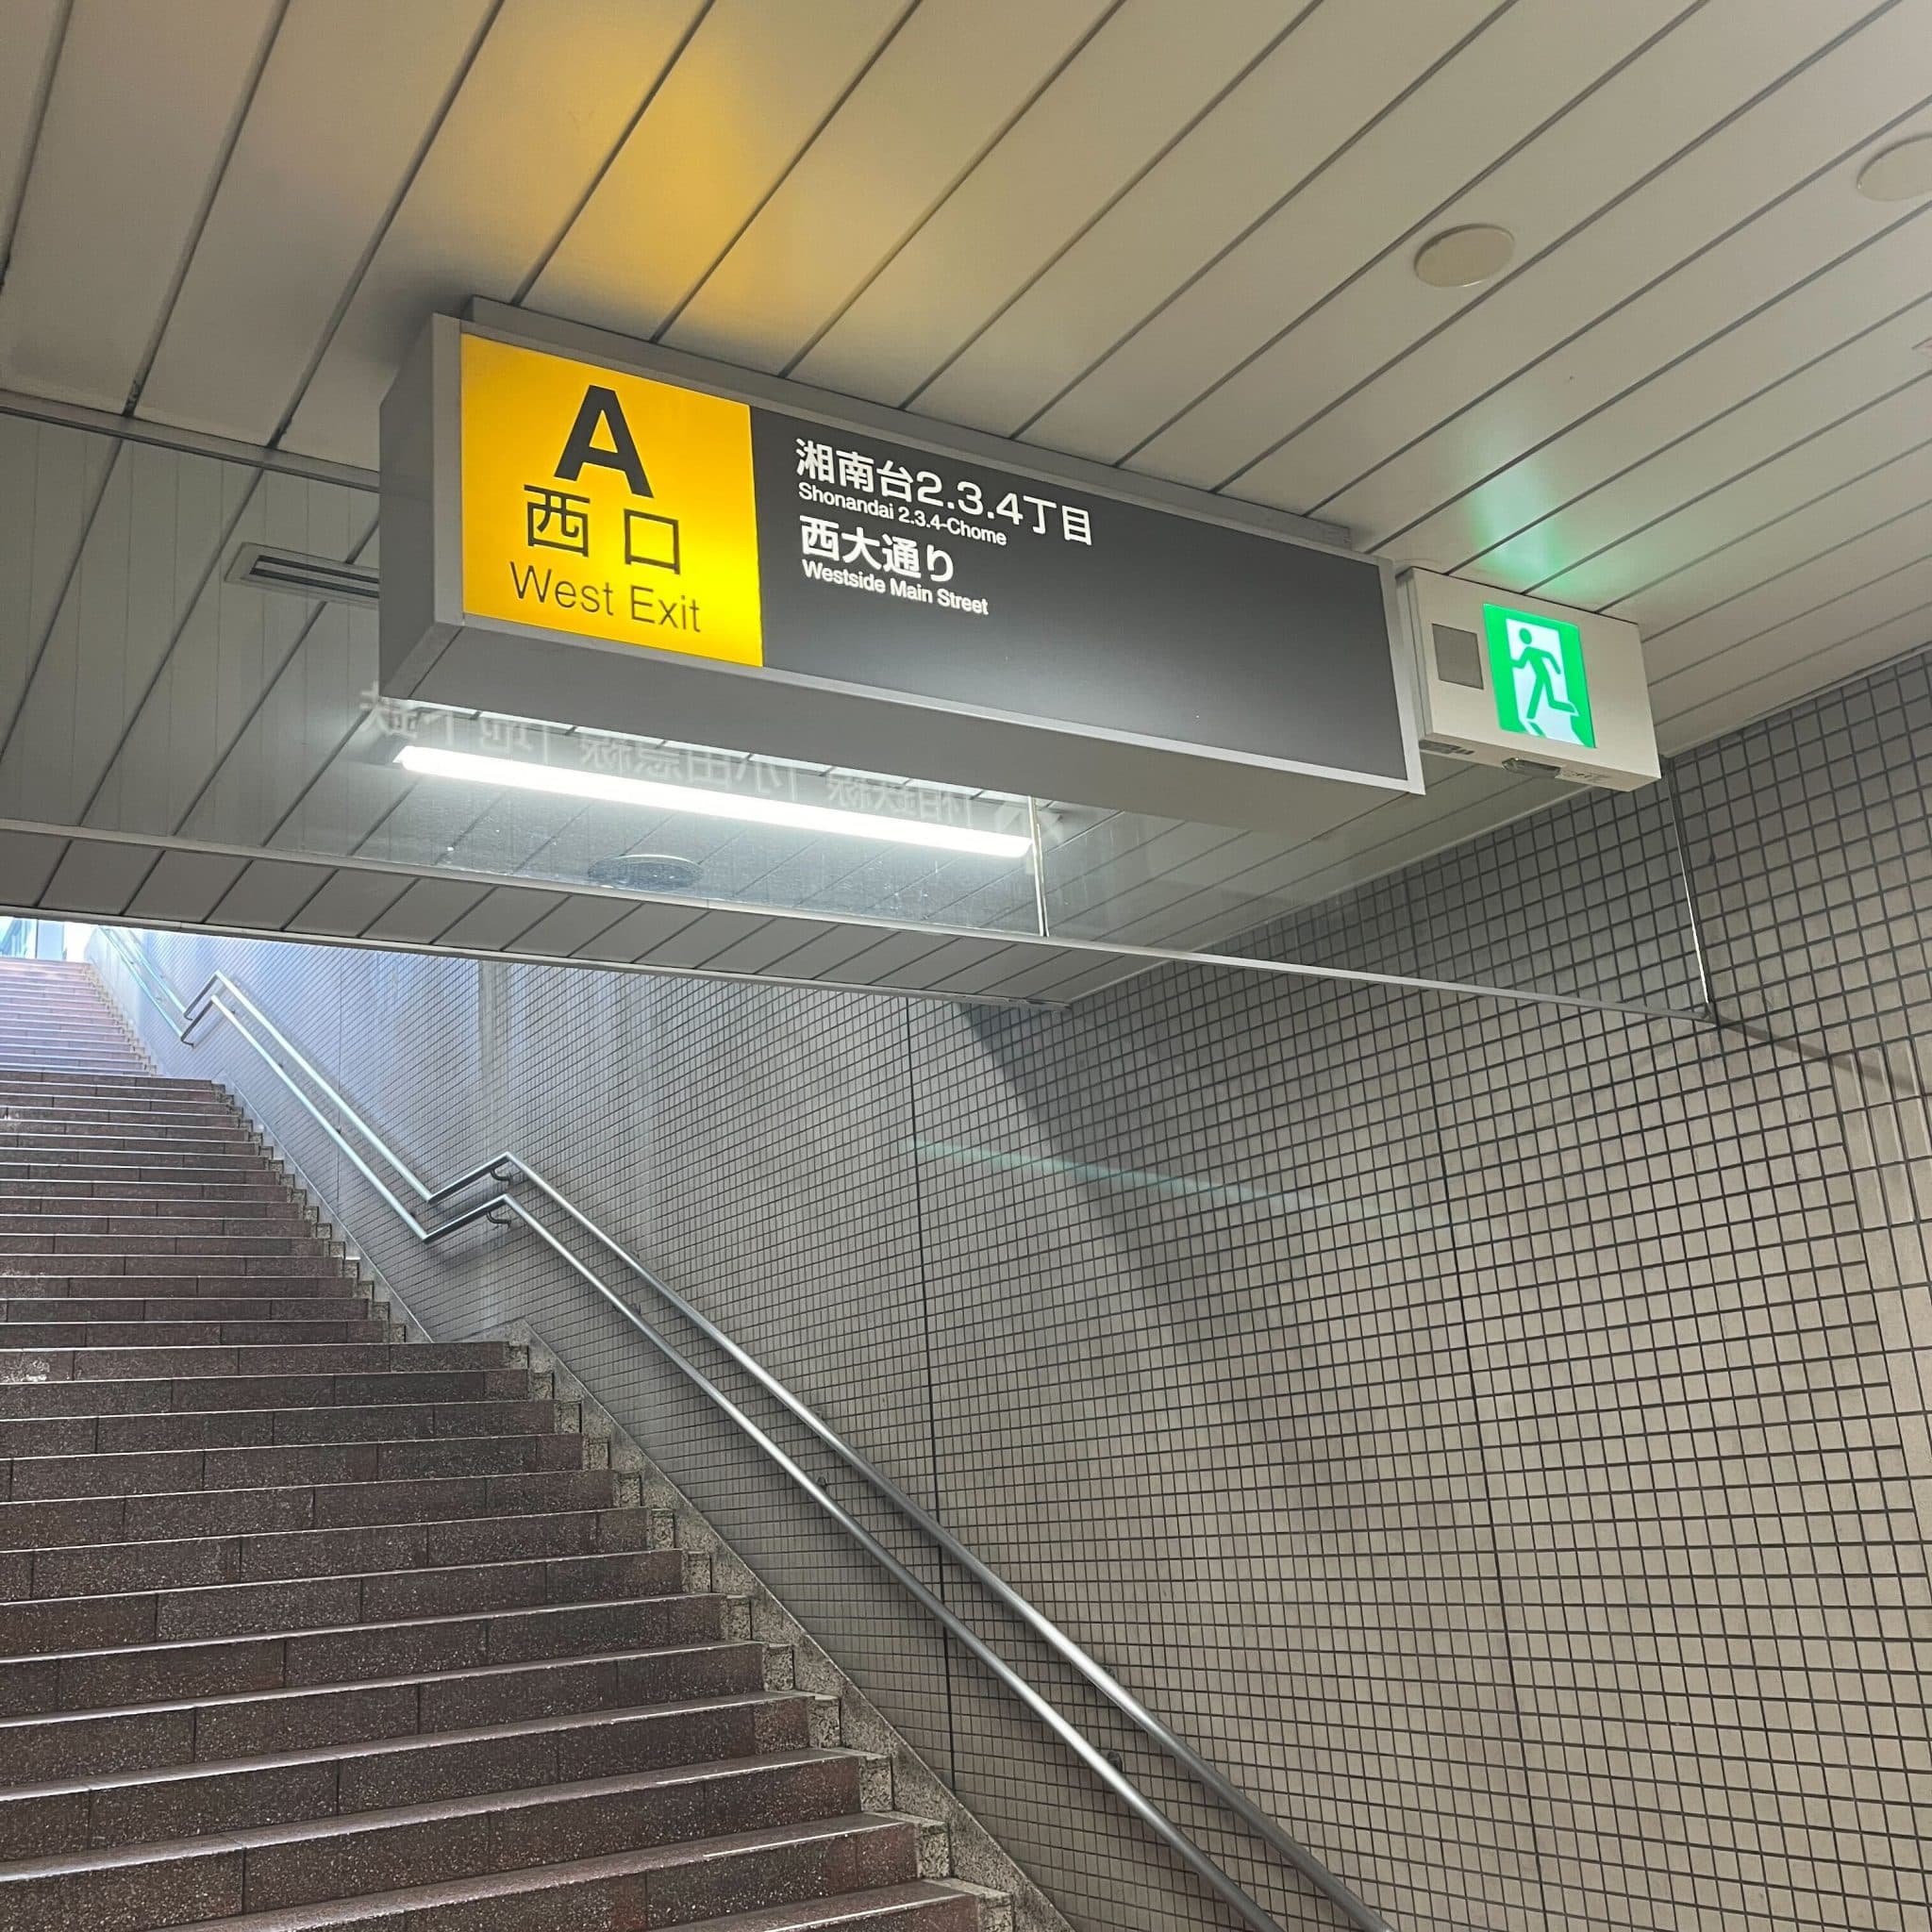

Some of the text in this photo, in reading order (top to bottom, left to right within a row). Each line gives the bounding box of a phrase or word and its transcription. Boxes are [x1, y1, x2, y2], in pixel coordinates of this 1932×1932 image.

[553, 384, 655, 499] A
[524, 484, 681, 575] 西口
[798, 481, 1008, 546] Shonandai 2.3.4-Chome
[800, 515, 955, 582] 西大通り
[509, 560, 702, 633] West Exit
[802, 558, 989, 615] Westside Main Street
